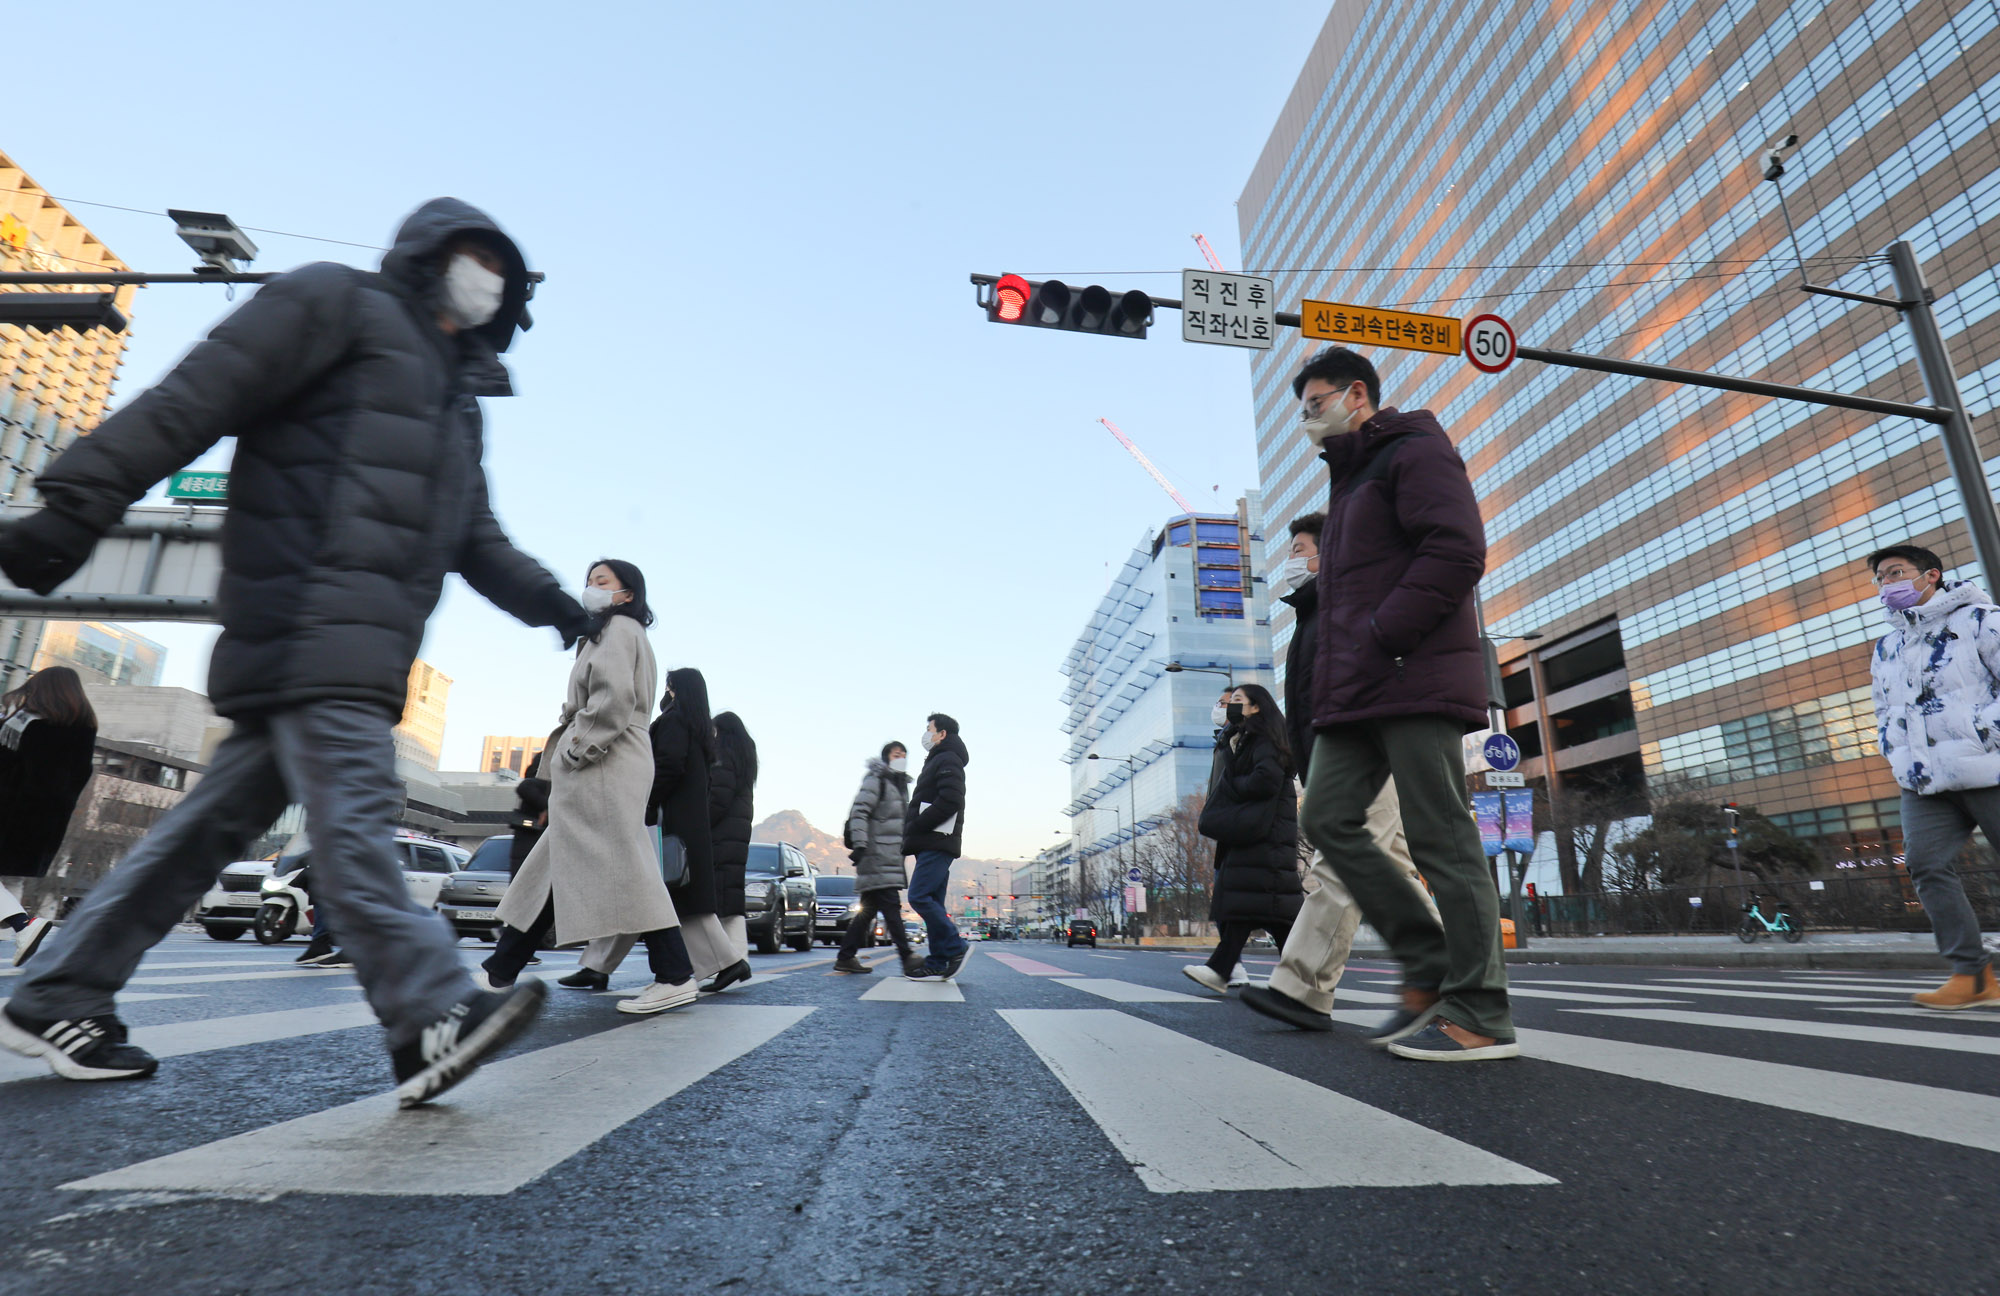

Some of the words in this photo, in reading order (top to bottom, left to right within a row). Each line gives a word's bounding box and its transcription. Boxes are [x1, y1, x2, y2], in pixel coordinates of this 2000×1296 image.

[1187, 310, 1270, 341] 직좌신호
[1314, 309, 1451, 348] 신호과속단속장비
[1475, 329, 1507, 358] 50
[177, 476, 229, 493] 세종대로
